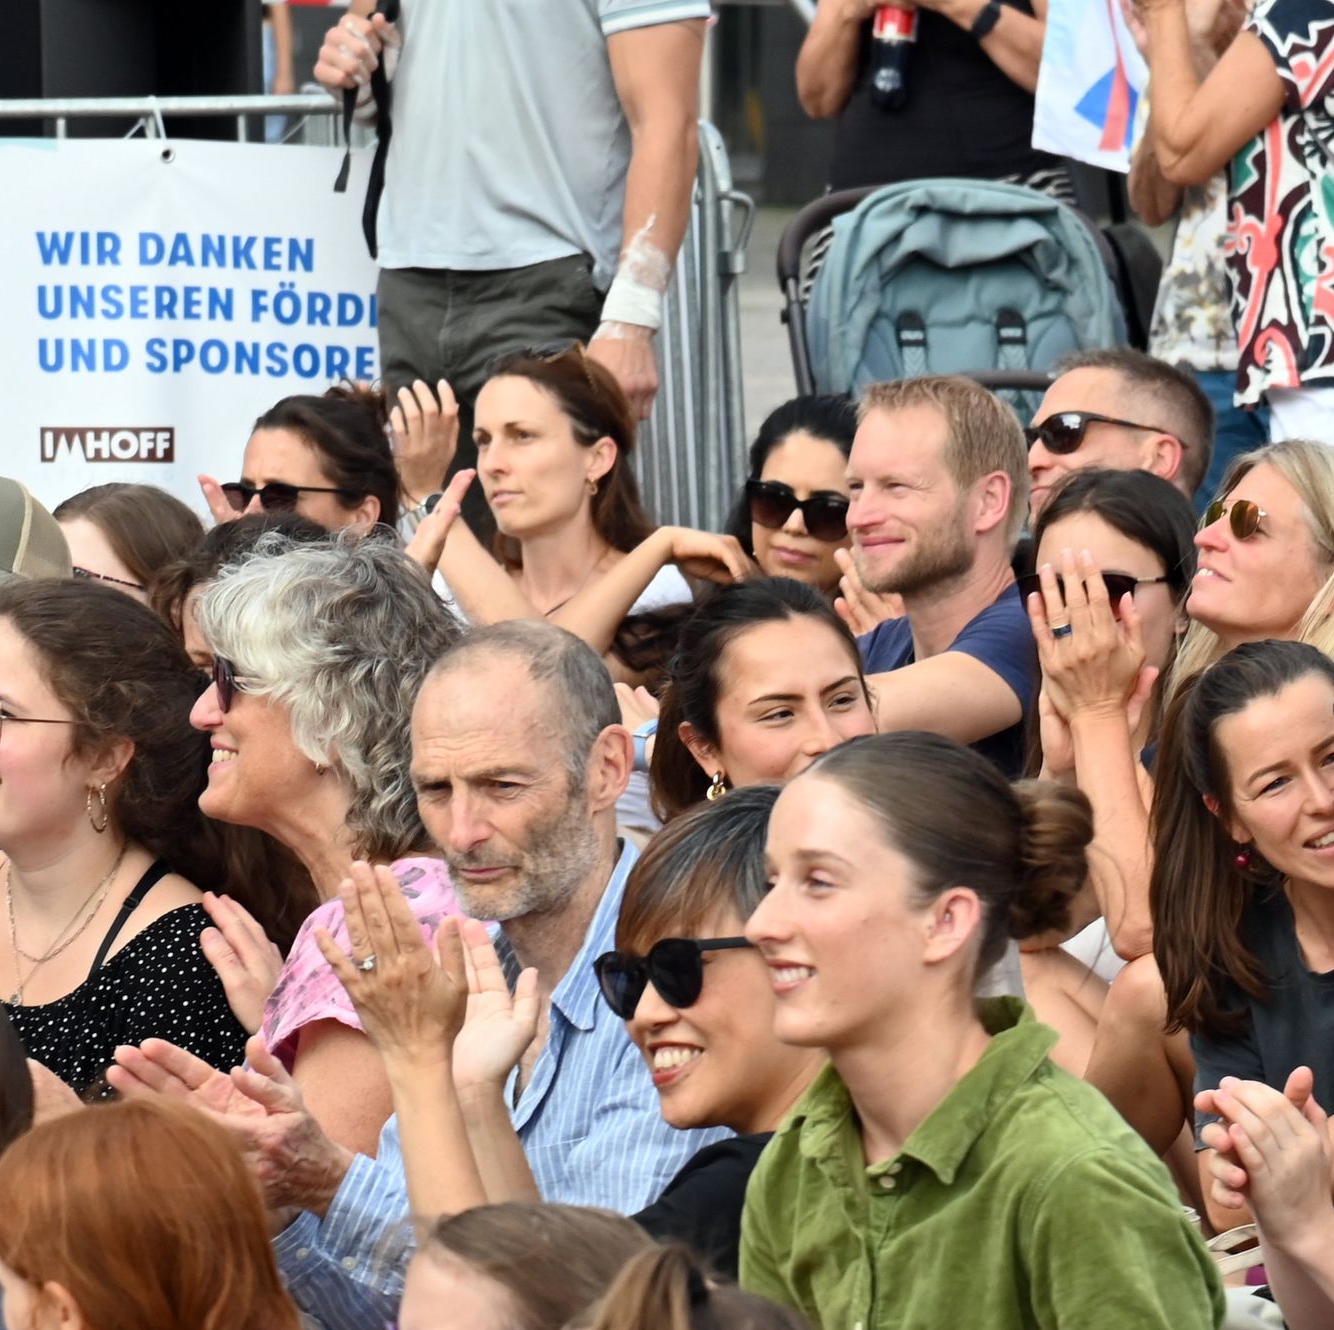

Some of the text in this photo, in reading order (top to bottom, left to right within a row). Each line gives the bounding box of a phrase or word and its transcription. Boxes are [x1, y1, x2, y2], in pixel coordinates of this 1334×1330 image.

[36, 231, 315, 273] WIR DANKEN
[37, 284, 234, 322] UNSEREN
[38, 338, 130, 373] UND
[42, 430, 171, 463] IMHOFF
